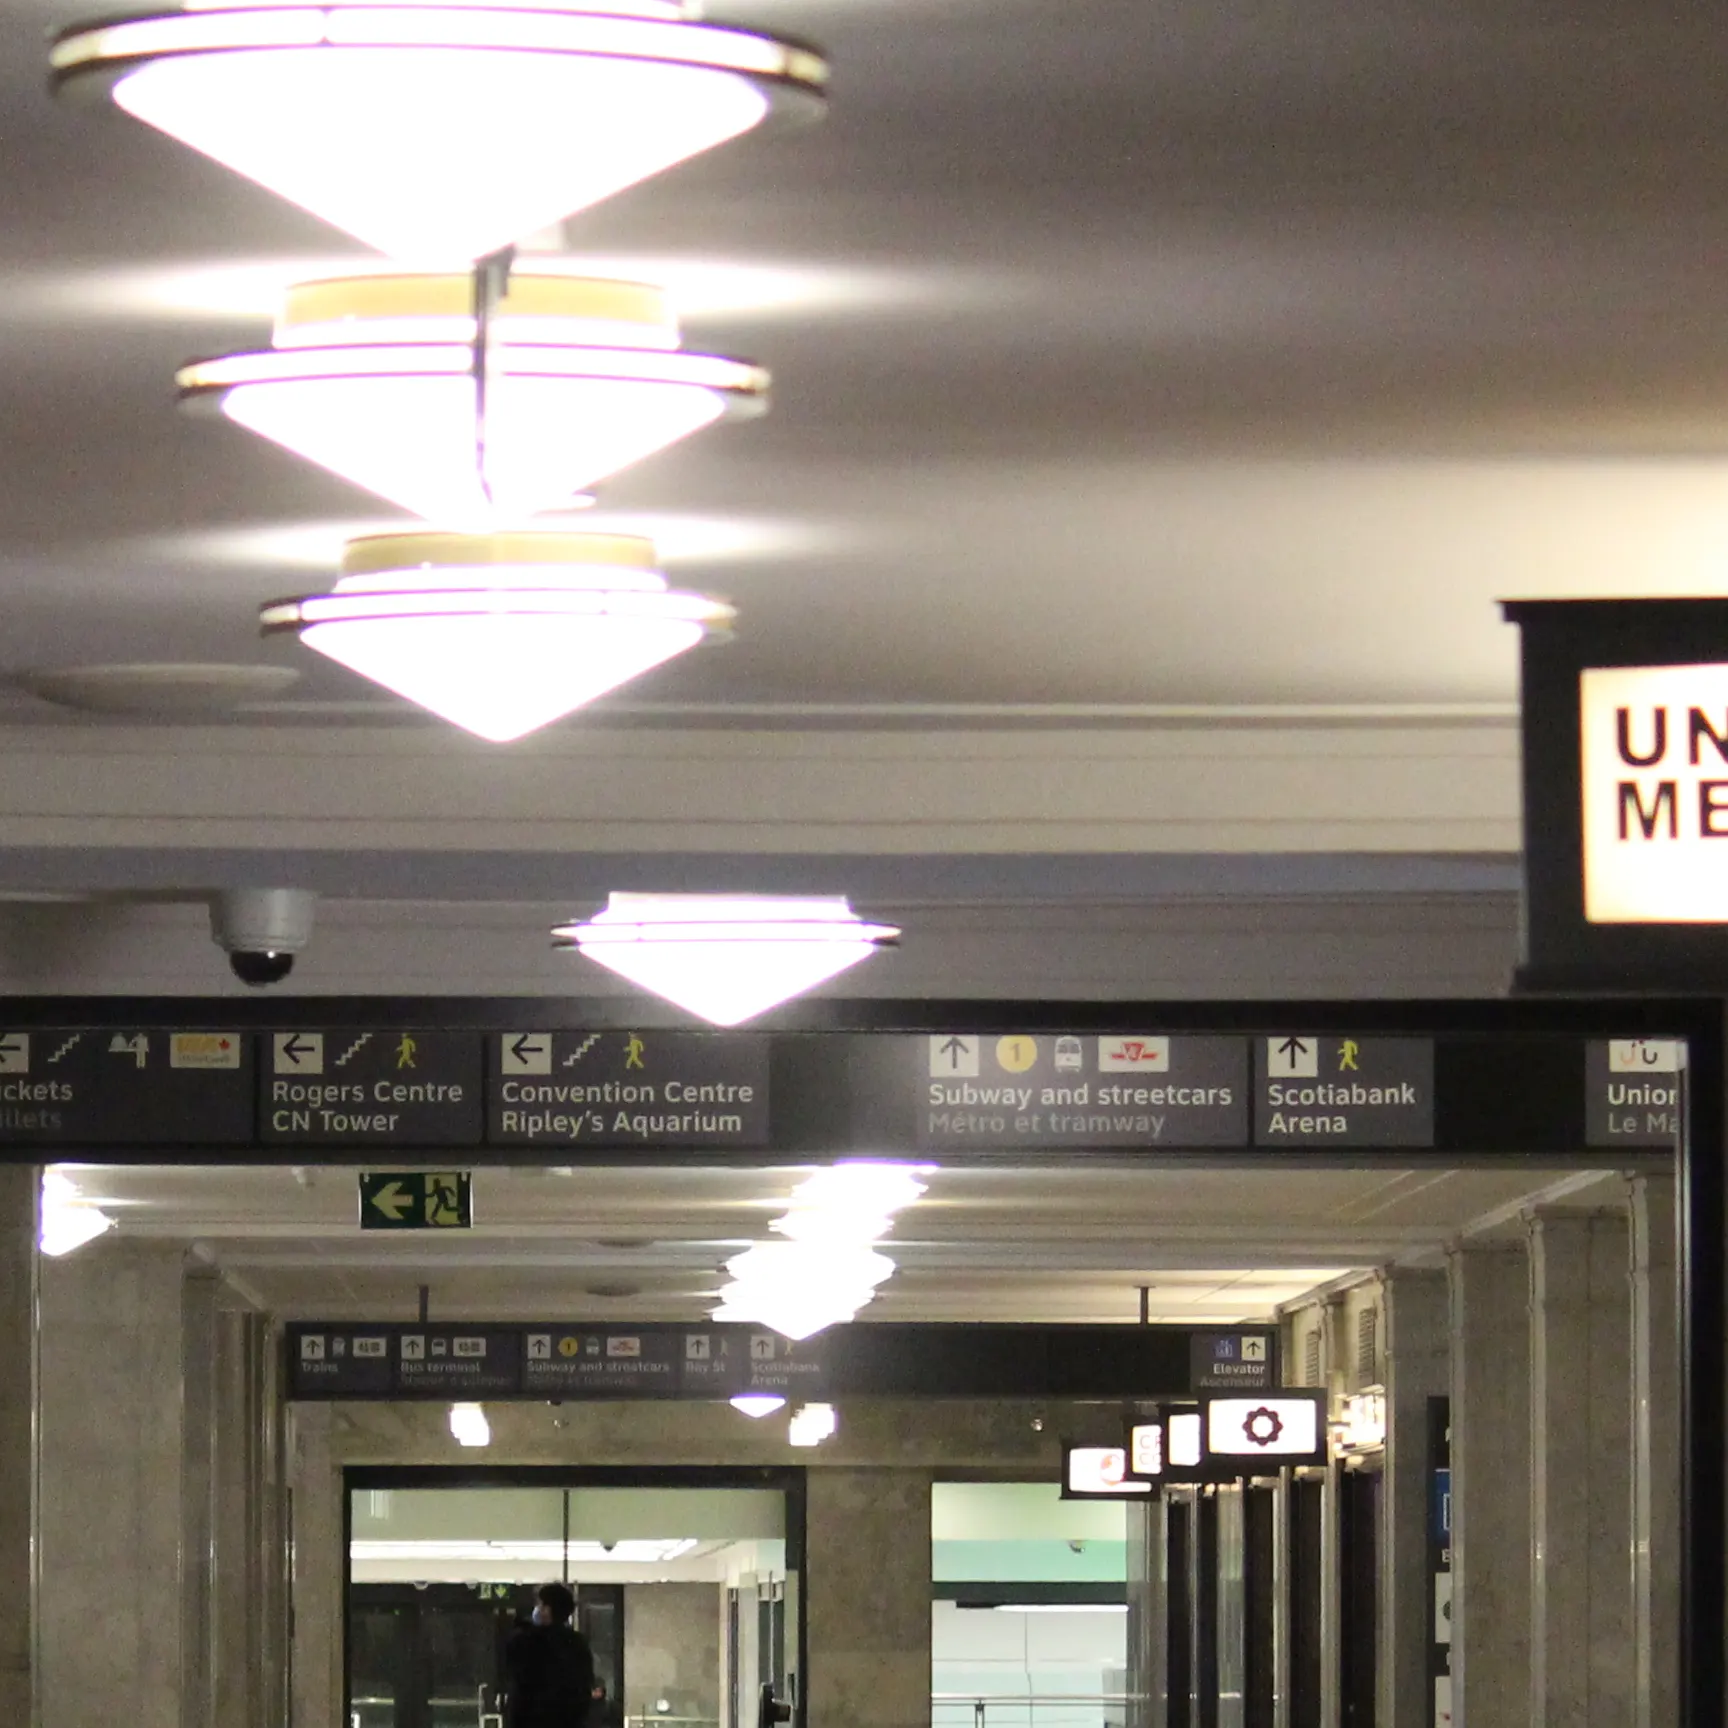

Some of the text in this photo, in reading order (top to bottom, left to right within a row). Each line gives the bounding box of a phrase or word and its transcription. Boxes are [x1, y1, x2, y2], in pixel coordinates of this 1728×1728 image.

[272, 1081, 463, 1108] Rogers Centre
[501, 1081, 754, 1102] Convention Centre
[929, 1083, 1232, 1110] Subway and streetcars
[1268, 1082, 1416, 1106] Scotiabank
[272, 1110, 399, 1132] CN Tower
[501, 1110, 742, 1137] Ripley's Aquarium
[928, 1111, 1165, 1139] Métro et tramway
[1268, 1112, 1348, 1133] Arena
[1608, 1112, 1637, 1133] Le
[302, 1361, 339, 1373] Trains
[526, 1361, 576, 1374] Subway
[579, 1361, 603, 1372] and
[1213, 1363, 1265, 1374] Elevator
